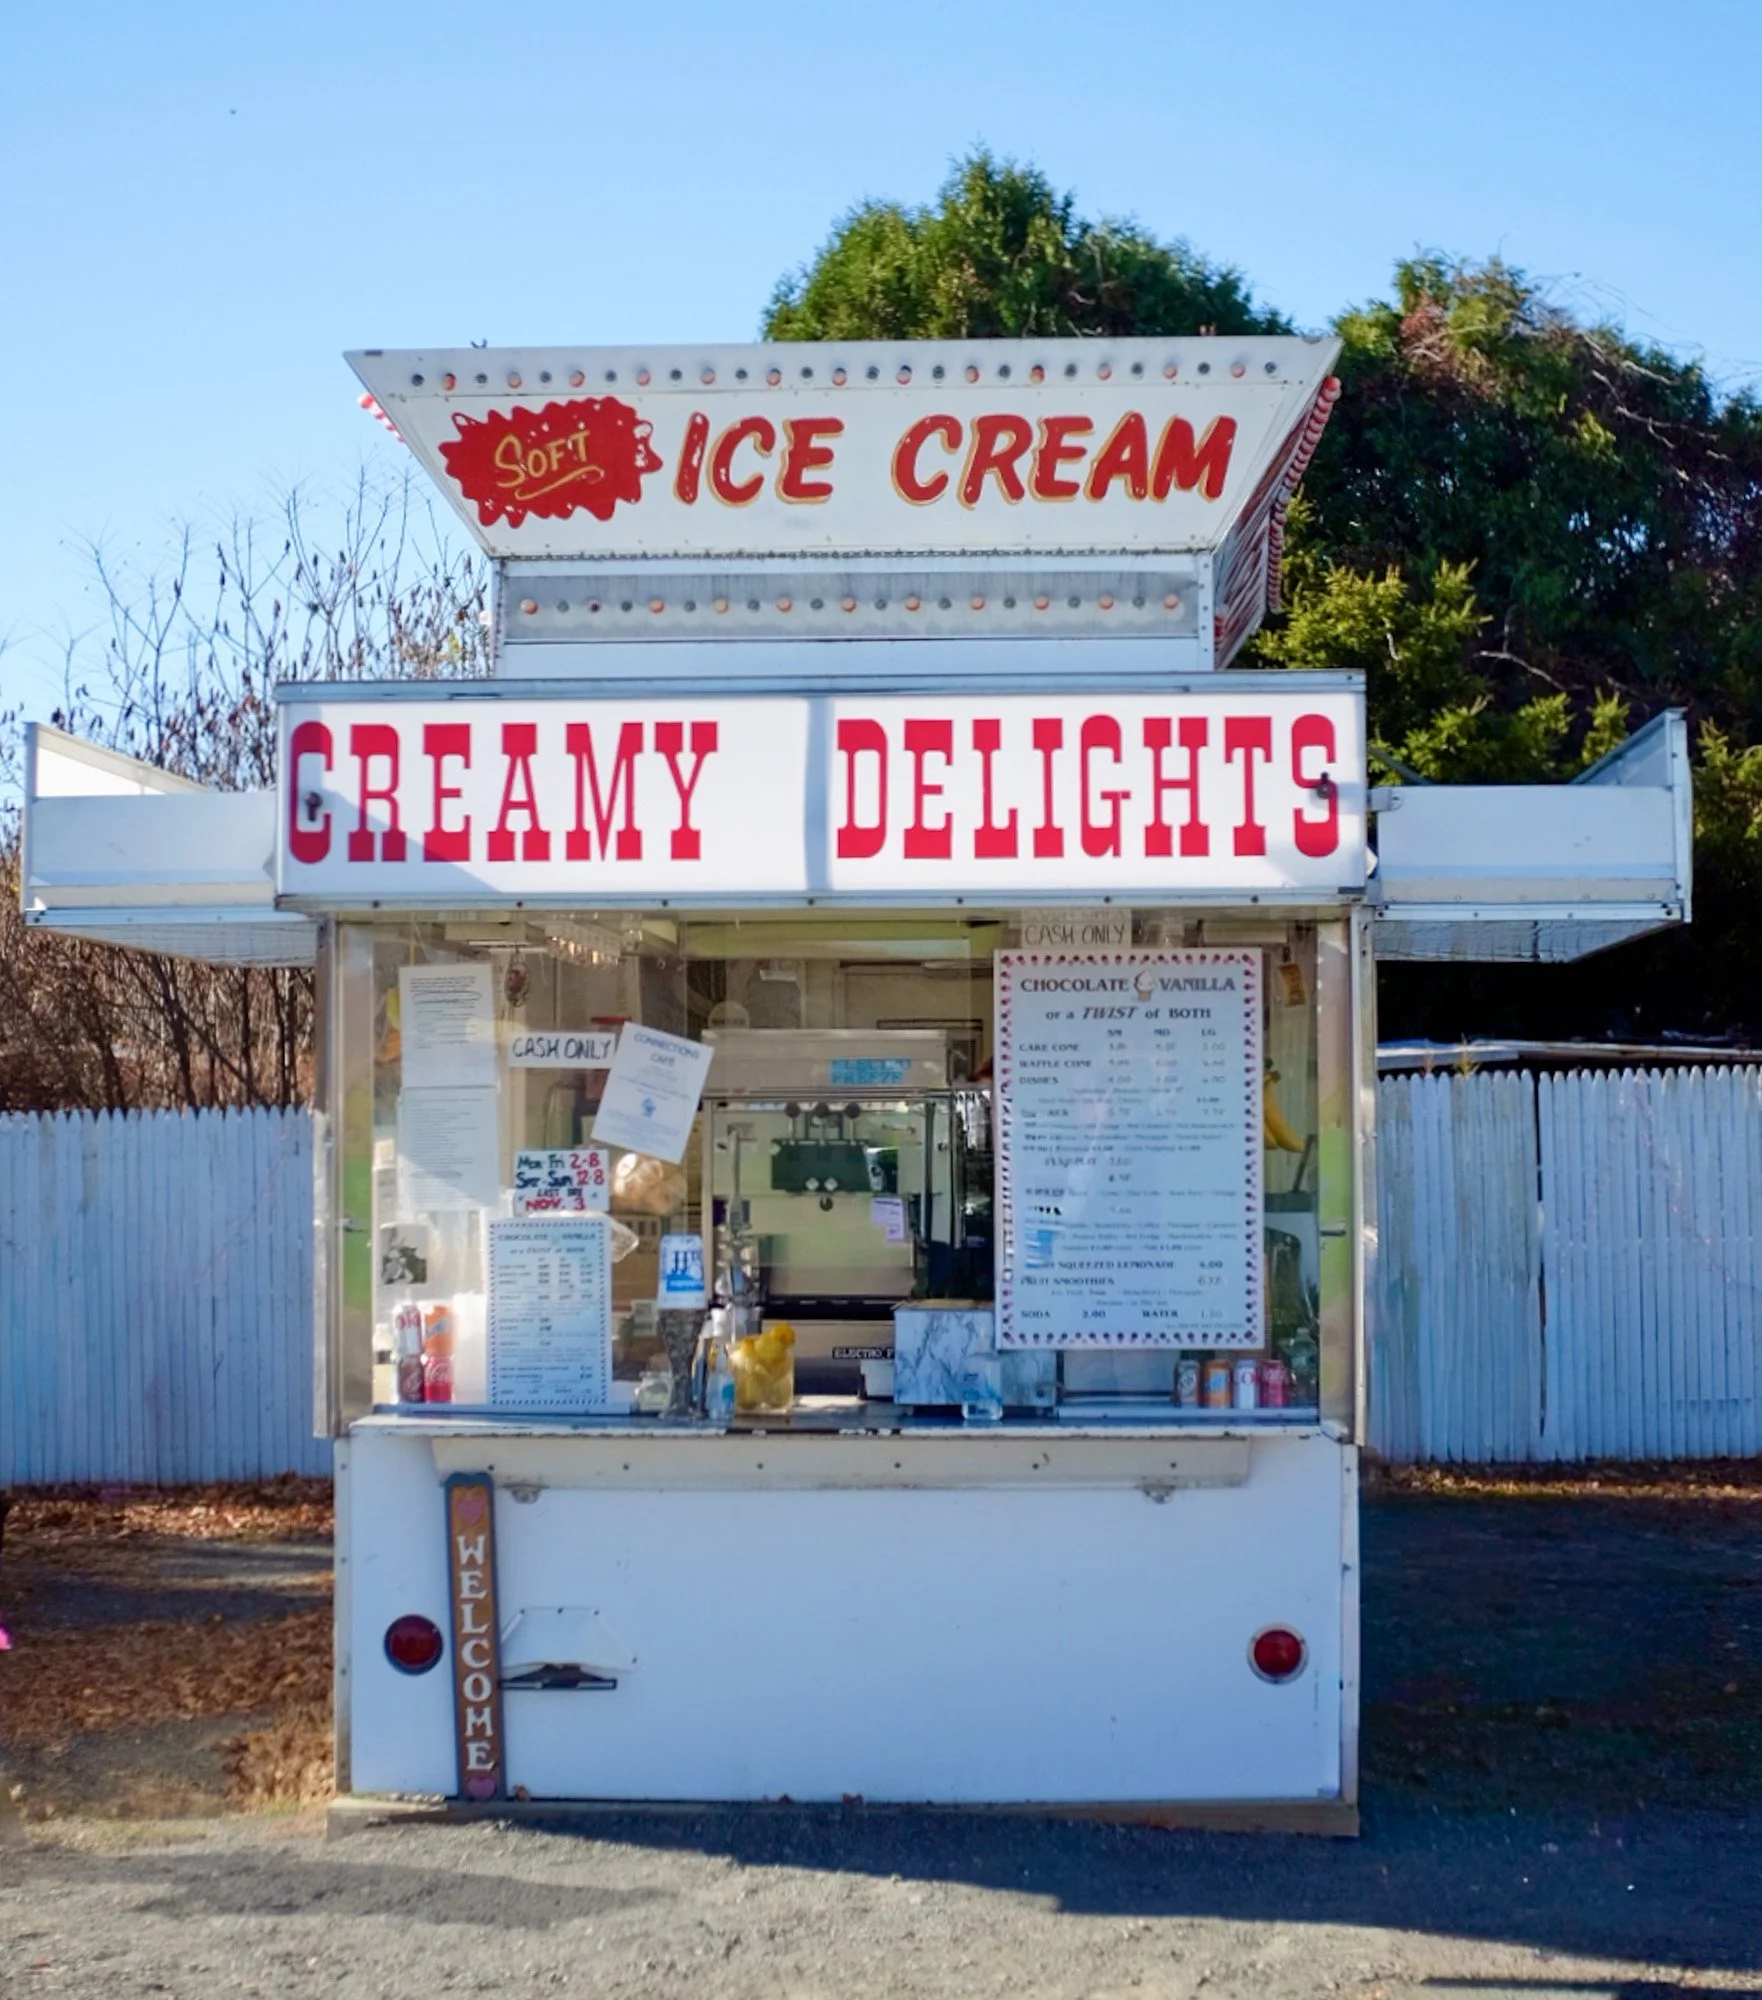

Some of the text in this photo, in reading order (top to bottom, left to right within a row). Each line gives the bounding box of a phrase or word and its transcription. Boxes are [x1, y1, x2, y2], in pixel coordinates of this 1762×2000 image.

[494, 411, 1238, 508] SOFT ICE CREAM
[289, 714, 1339, 863] CREAMY DELIGHTS
[1024, 923, 1125, 946] CASH ONLY
[1020, 977, 1238, 993] CHOCOLATE VANILLA
[1045, 1005, 1212, 1020] or a TWIST of BOTH
[1200, 1028, 1217, 1037] LG
[512, 1036, 612, 1060] CASH ONLY
[1051, 1043, 1081, 1052] CONE
[1063, 1059, 1092, 1068] CONE
[1020, 1309, 1051, 1319] SODA
[1142, 1309, 1179, 1319] WATER
[457, 1536, 497, 1773] WELCOME
